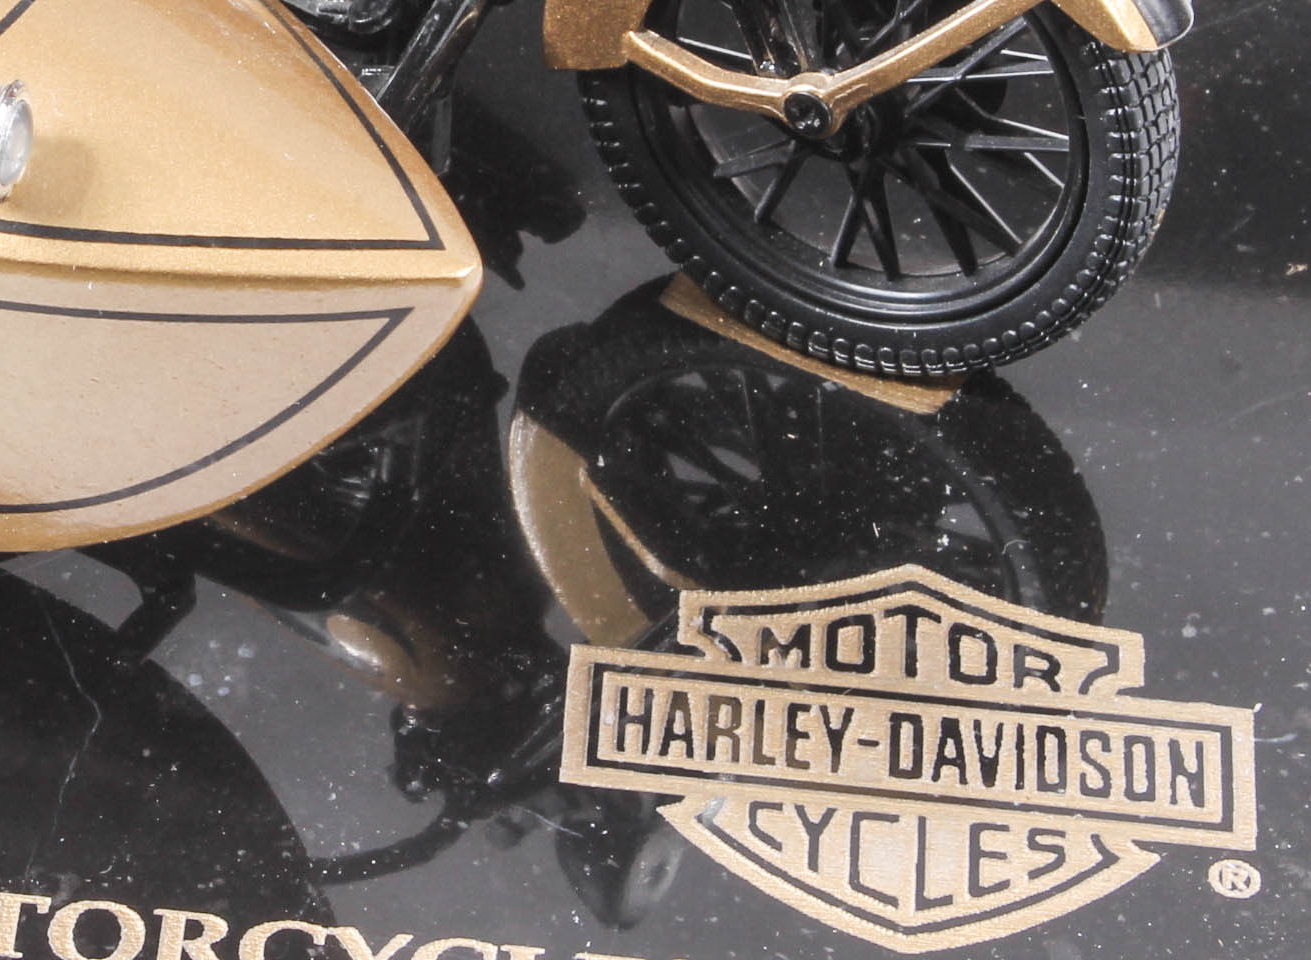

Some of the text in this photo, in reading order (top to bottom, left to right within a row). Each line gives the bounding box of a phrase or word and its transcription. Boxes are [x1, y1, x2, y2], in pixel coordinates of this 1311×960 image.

[758, 603, 1062, 695] MOTOR
[615, 685, 1206, 809] HARLEY-DAVIDSON
[747, 800, 1067, 911] CYCLES
